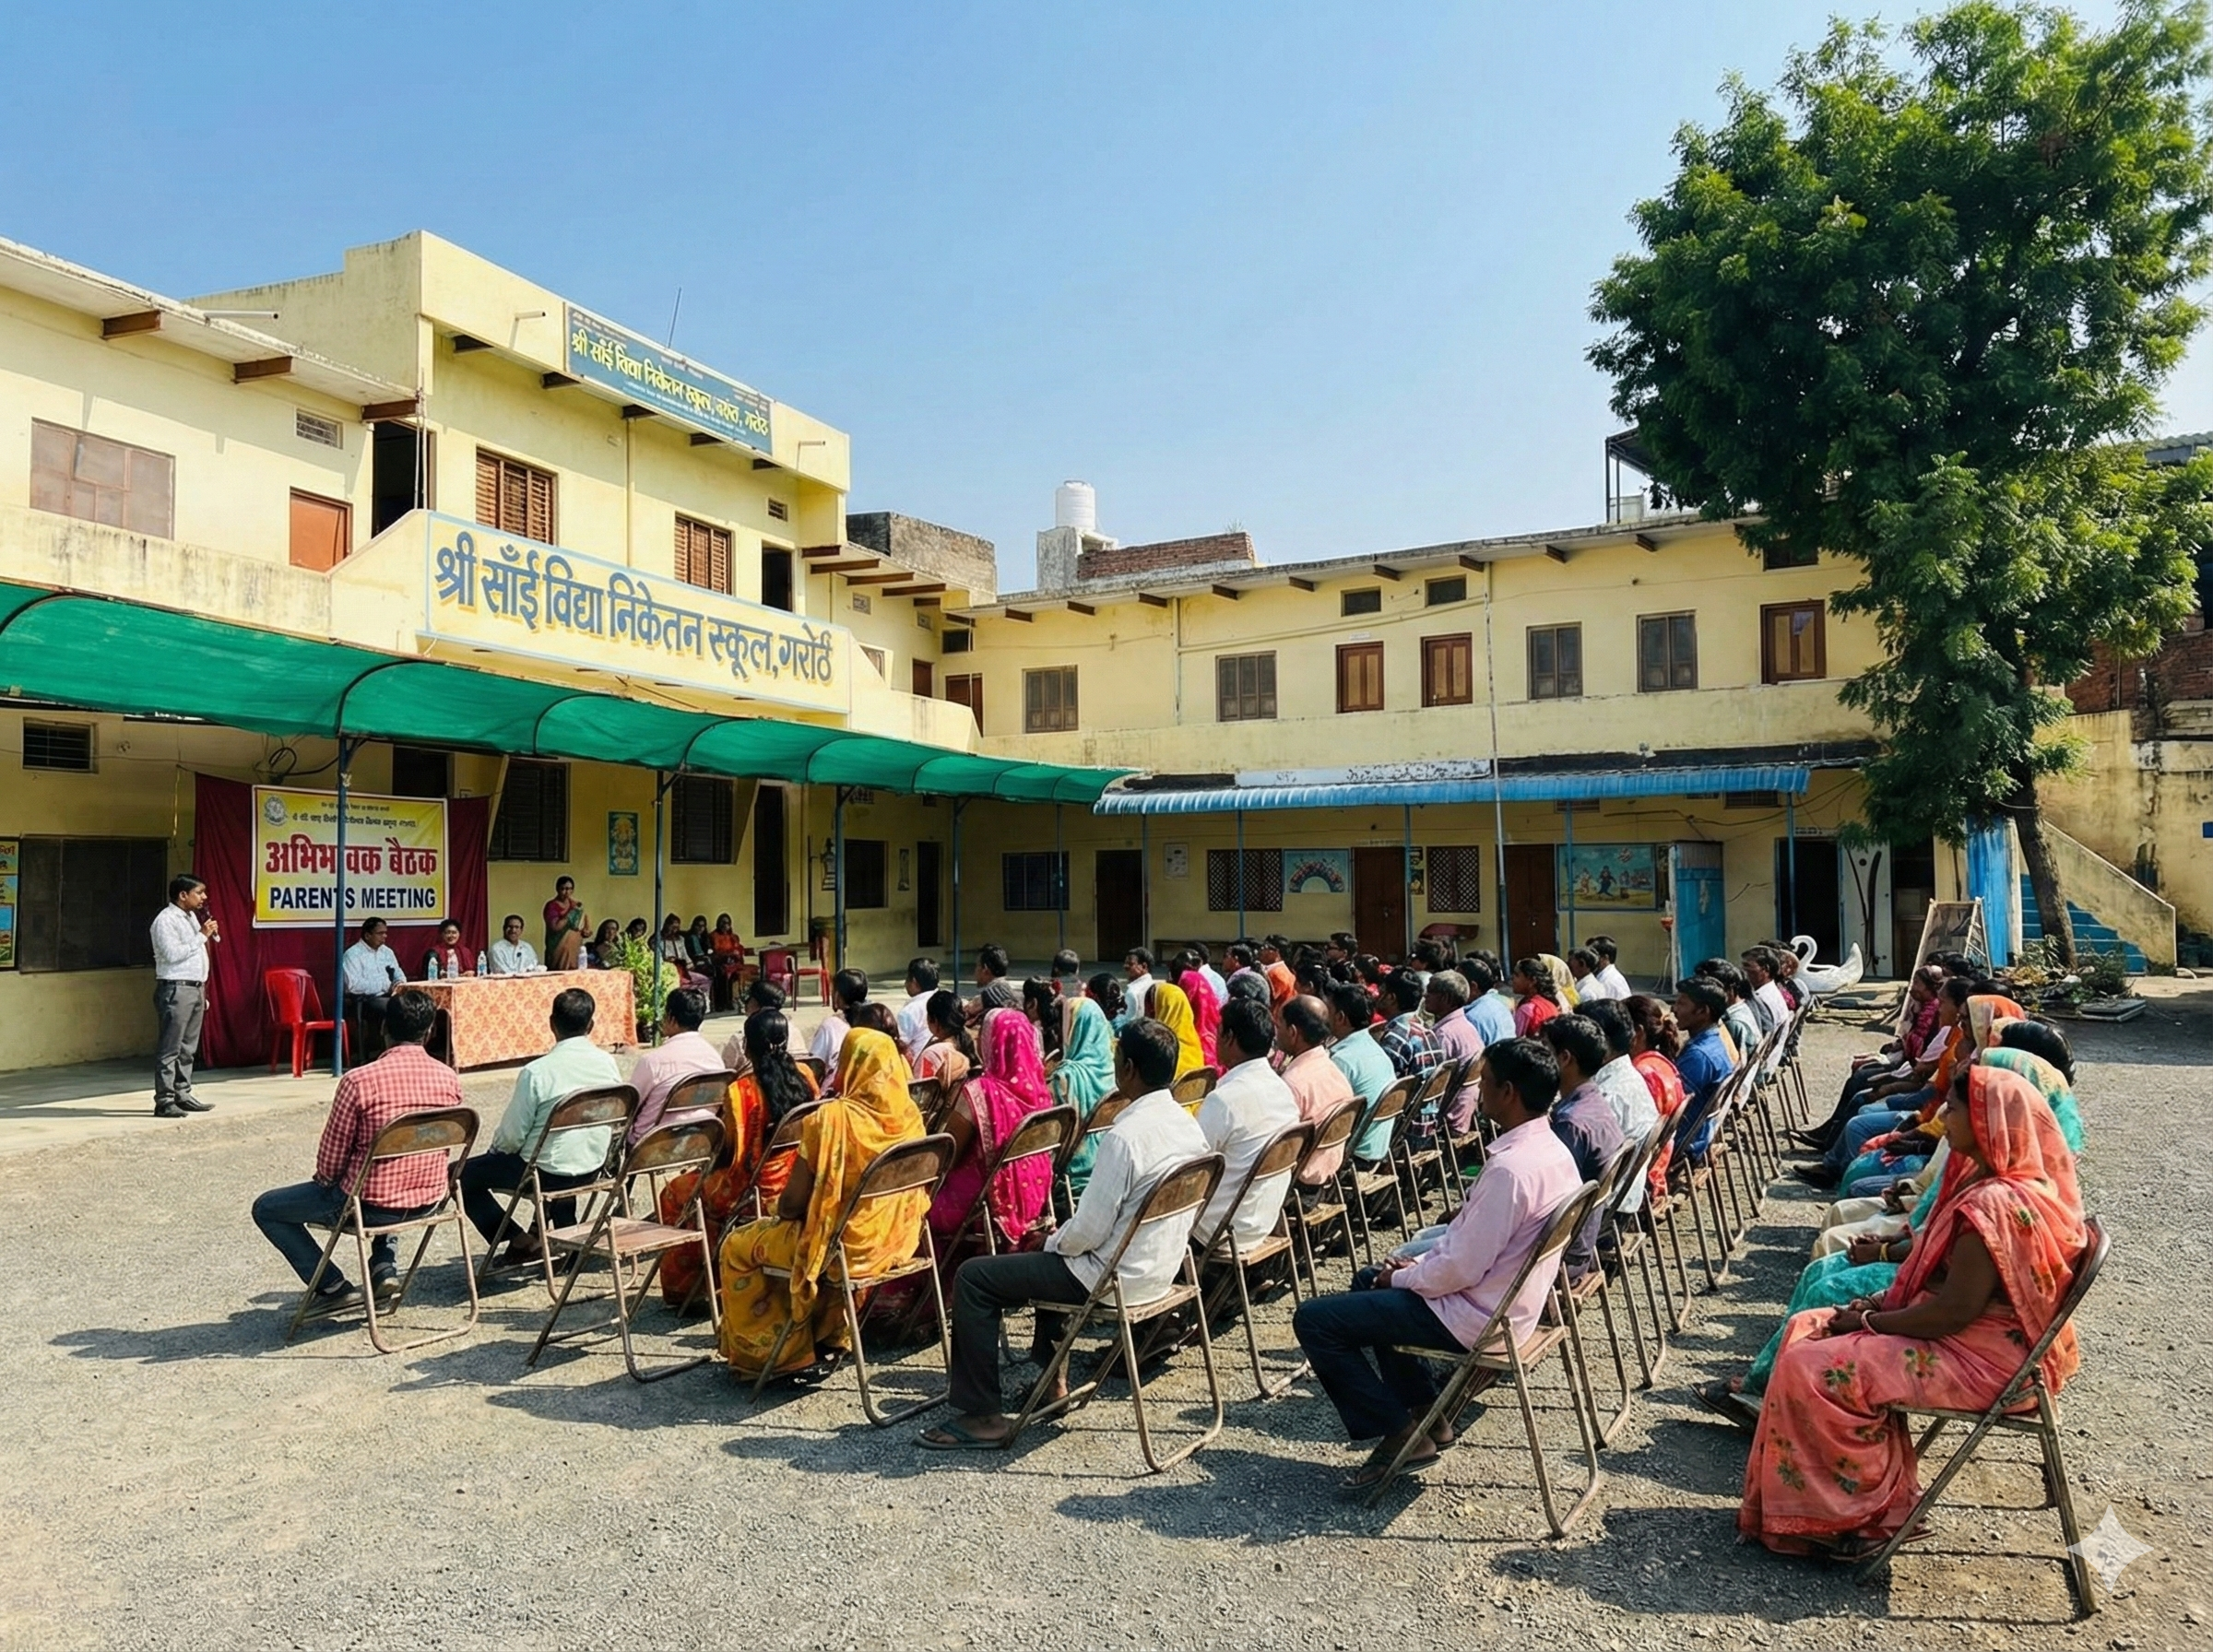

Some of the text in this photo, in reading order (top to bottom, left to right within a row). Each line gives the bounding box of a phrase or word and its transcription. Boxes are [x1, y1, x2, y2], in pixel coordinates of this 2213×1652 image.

[434, 531, 477, 608] श्री
[542, 555, 605, 635] विद्या
[607, 572, 704, 656] निकेतन
[265, 833, 438, 876] अभिभवक बैठक
[361, 886, 436, 909] MEETING
